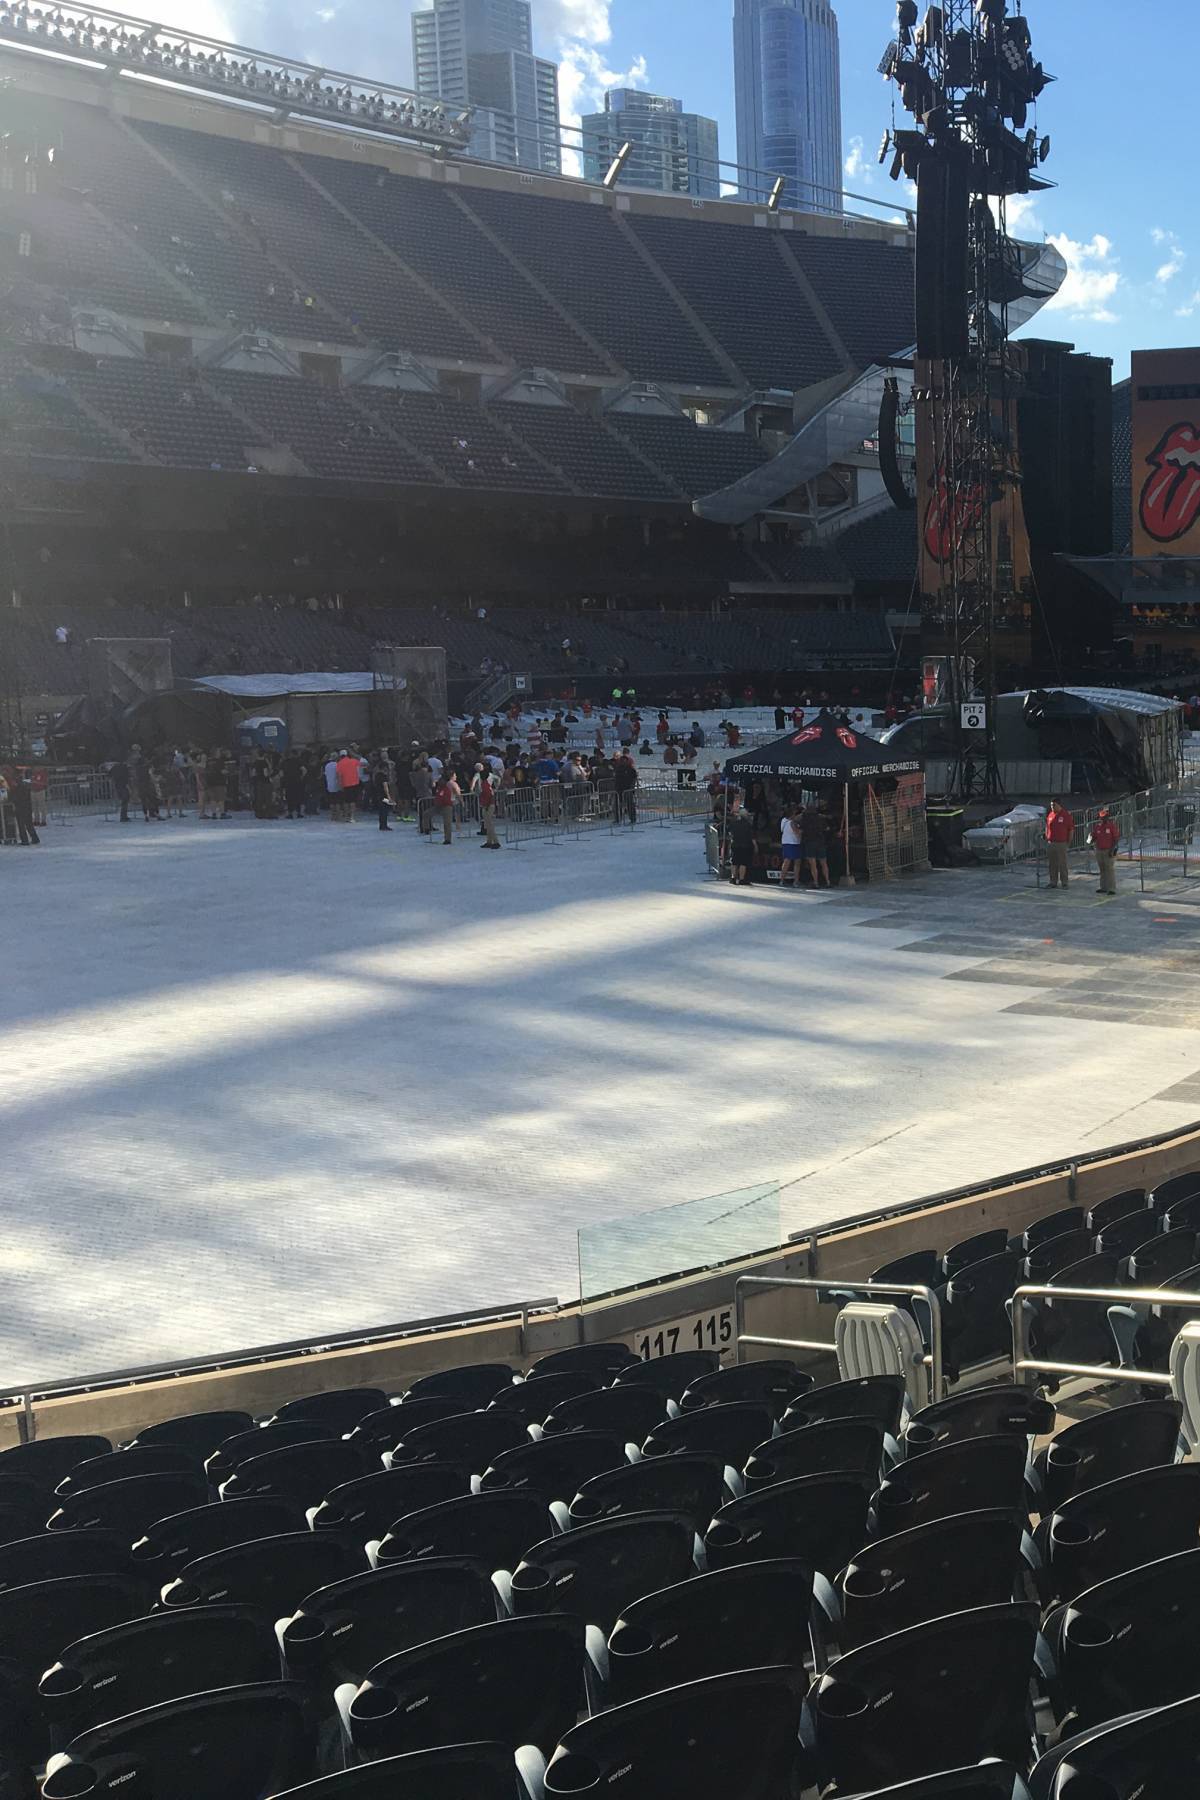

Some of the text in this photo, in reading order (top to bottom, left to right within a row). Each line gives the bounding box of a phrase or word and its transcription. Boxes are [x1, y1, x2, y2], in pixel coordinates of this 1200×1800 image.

[733, 764, 837, 777] OFFICIAL MERCHANDISE
[851, 761, 920, 777] OFFICIAL MERCHANDISE
[682, 774, 690, 786] K
[640, 1312, 731, 1360] 117 115
[332, 1623, 353, 1637] verizon
[93, 1674, 117, 1689] verizon
[406, 1696, 429, 1713] verizon
[873, 1691, 893, 1709] verizon
[108, 1770, 136, 1788] verizon
[608, 1764, 633, 1784] verizon
